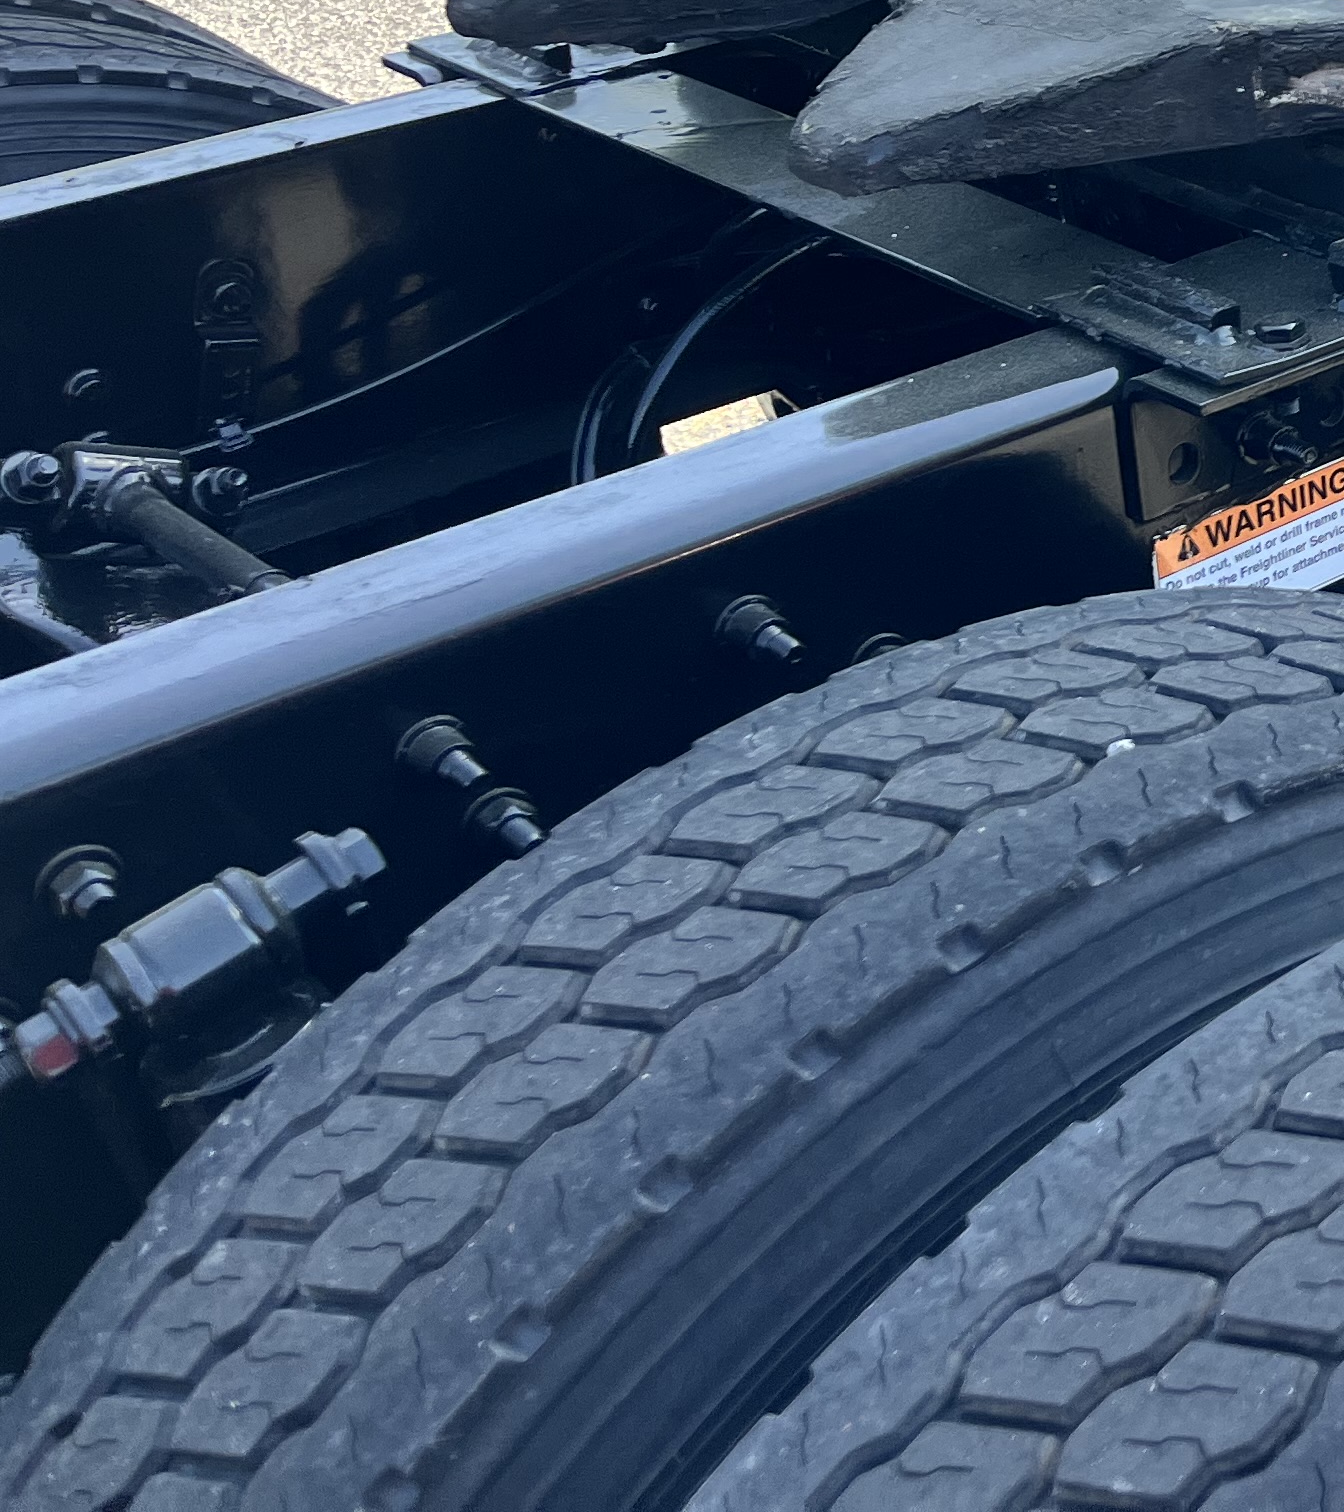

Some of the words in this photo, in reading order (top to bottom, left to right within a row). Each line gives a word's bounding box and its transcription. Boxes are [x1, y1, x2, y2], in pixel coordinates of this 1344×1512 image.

[1186, 567, 1206, 584] not
[1208, 557, 1232, 575] cut,
[1235, 541, 1262, 563] weld
[1264, 537, 1277, 550] or
[1280, 524, 1303, 545] drill
[1305, 510, 1338, 533] frame
[1218, 572, 1238, 586] the
[1240, 538, 1307, 579] Freightliner
[1272, 566, 1290, 582] for
